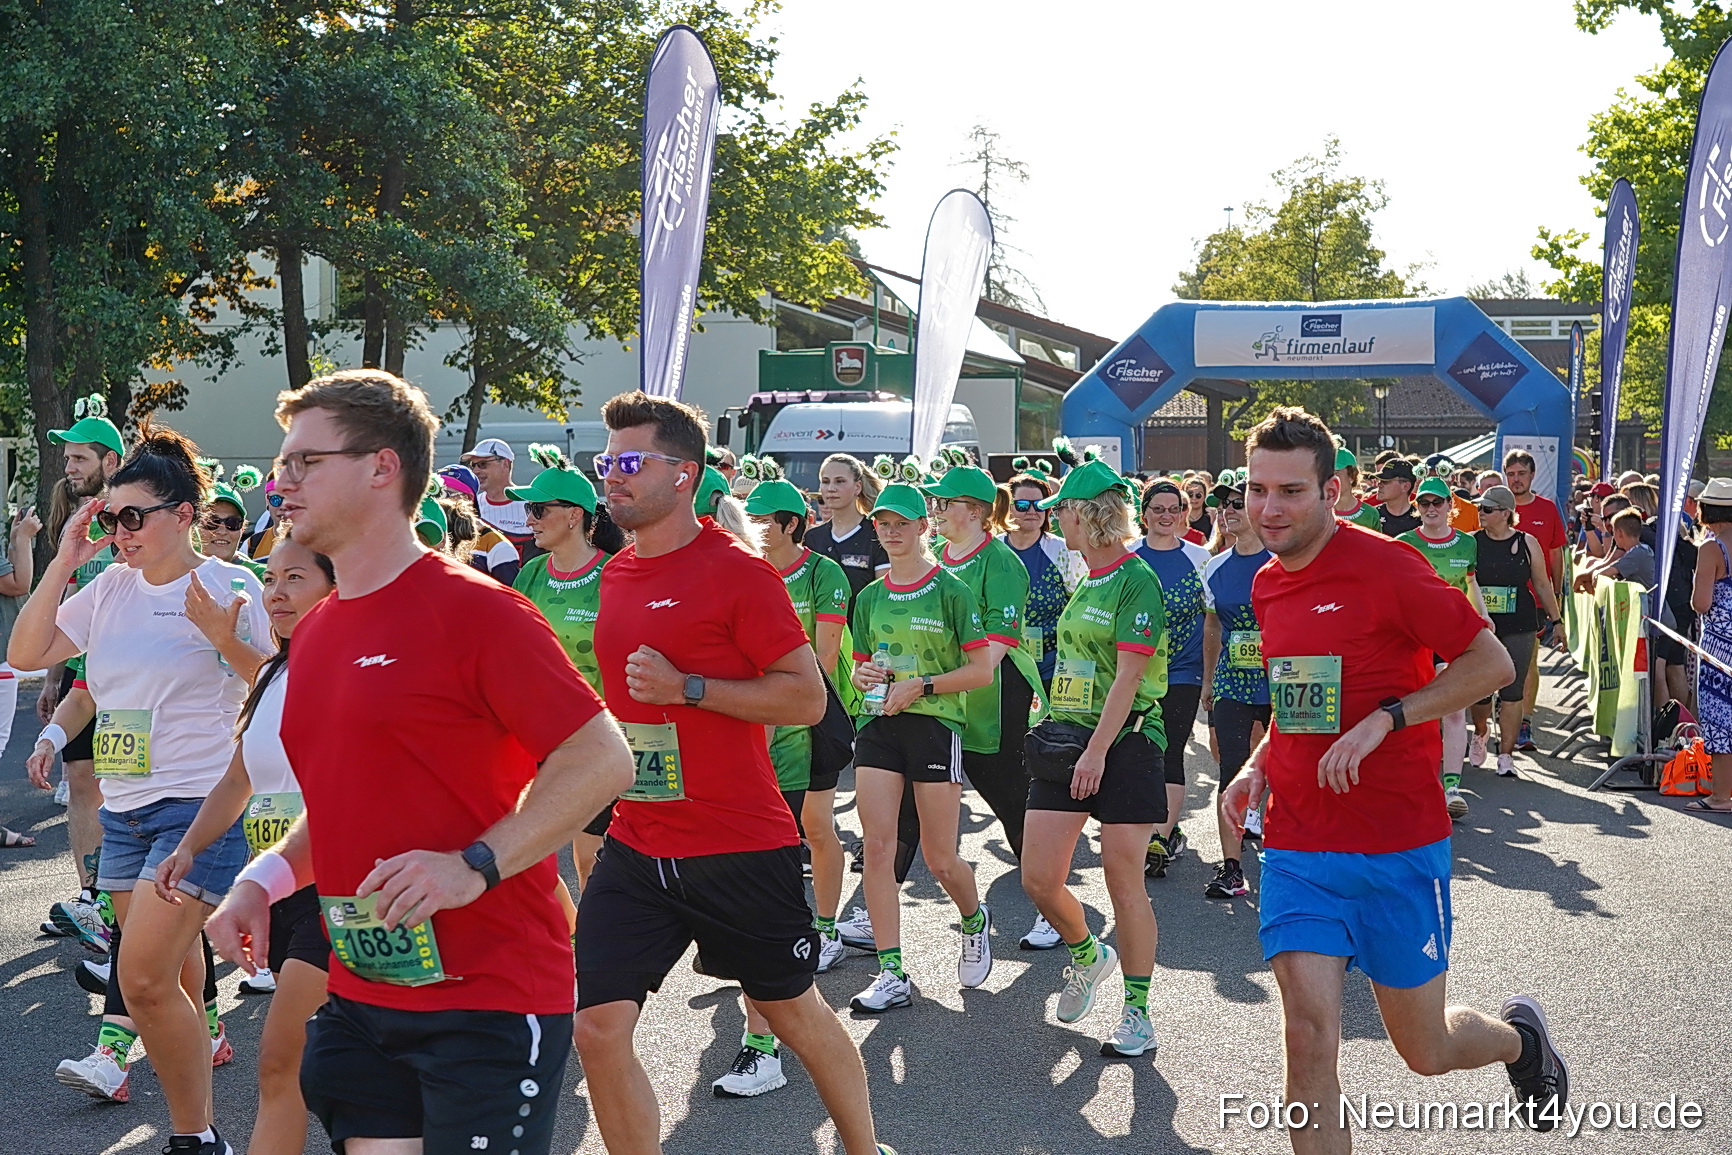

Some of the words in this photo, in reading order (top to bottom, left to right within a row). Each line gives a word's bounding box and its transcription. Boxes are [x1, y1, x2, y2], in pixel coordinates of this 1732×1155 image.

[668, 65, 698, 205] Fischer
[684, 86, 705, 198] AUTOMOBILE
[1613, 204, 1630, 304] Fischer
[1309, 321, 1339, 330] Fischer
[670, 283, 692, 400] r-automobile.de
[1286, 336, 1376, 355] firmenlauf
[1115, 366, 1163, 378] Fischer
[887, 583, 938, 602] MONSTERSTARK
[910, 616, 945, 628] TRENDHAUS
[1057, 676, 1073, 695] 87
[1082, 681, 1091, 705] 2022
[1275, 682, 1324, 709] 1678
[1326, 686, 1336, 722] 2022
[1289, 710, 1322, 720] Matthias
[96, 733, 136, 756] 1879
[137, 737, 146, 769] 2022
[108, 757, 138, 765] Margarita
[632, 751, 664, 776] 74
[664, 754, 678, 790] 2022
[927, 763, 947, 771] adidas
[633, 779, 667, 787] exander
[252, 817, 290, 843] 1876
[344, 922, 413, 959] 1683
[413, 921, 435, 970] 2022
[1430, 932, 1439, 961] adidas
[470, 1135, 489, 1150] 30
